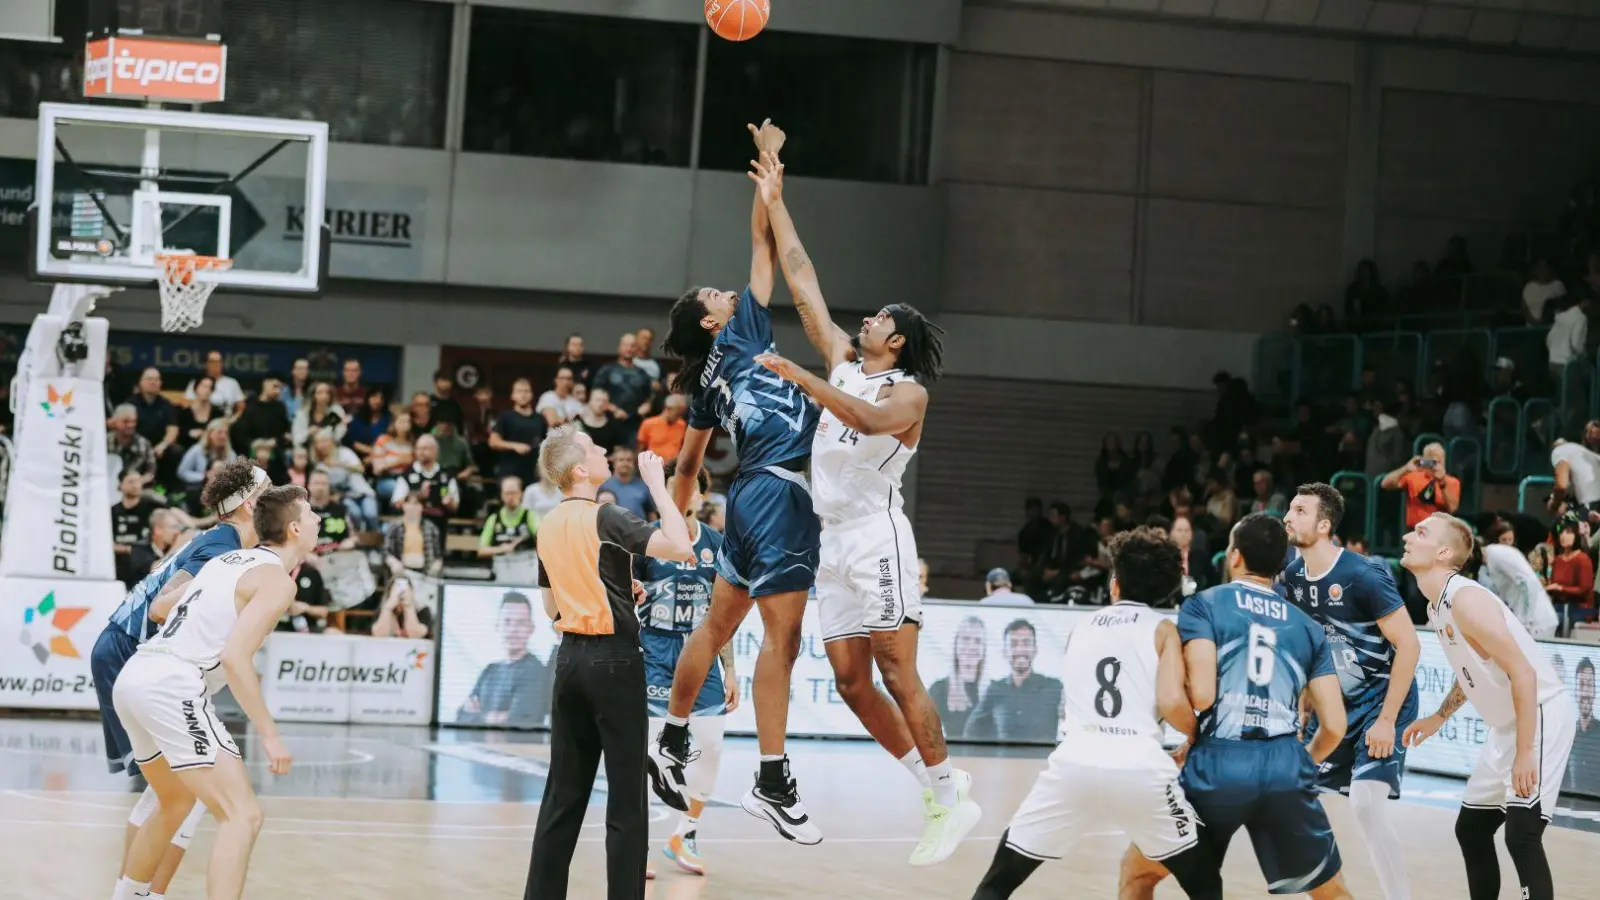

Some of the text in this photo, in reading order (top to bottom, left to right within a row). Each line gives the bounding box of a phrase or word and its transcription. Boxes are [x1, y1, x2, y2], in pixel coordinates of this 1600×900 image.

[115, 49, 219, 86] tipico
[286, 206, 411, 239] KRIER
[154, 345, 270, 371] LOUGE
[456, 365, 478, 388] G
[839, 423, 859, 446] 24
[53, 424, 83, 574] Piotrowski
[1235, 590, 1288, 621] LASISI
[1309, 585, 1319, 608] 9
[1247, 622, 1277, 687] 6
[278, 660, 408, 684] Piotrowski
[1094, 656, 1123, 719] 8
